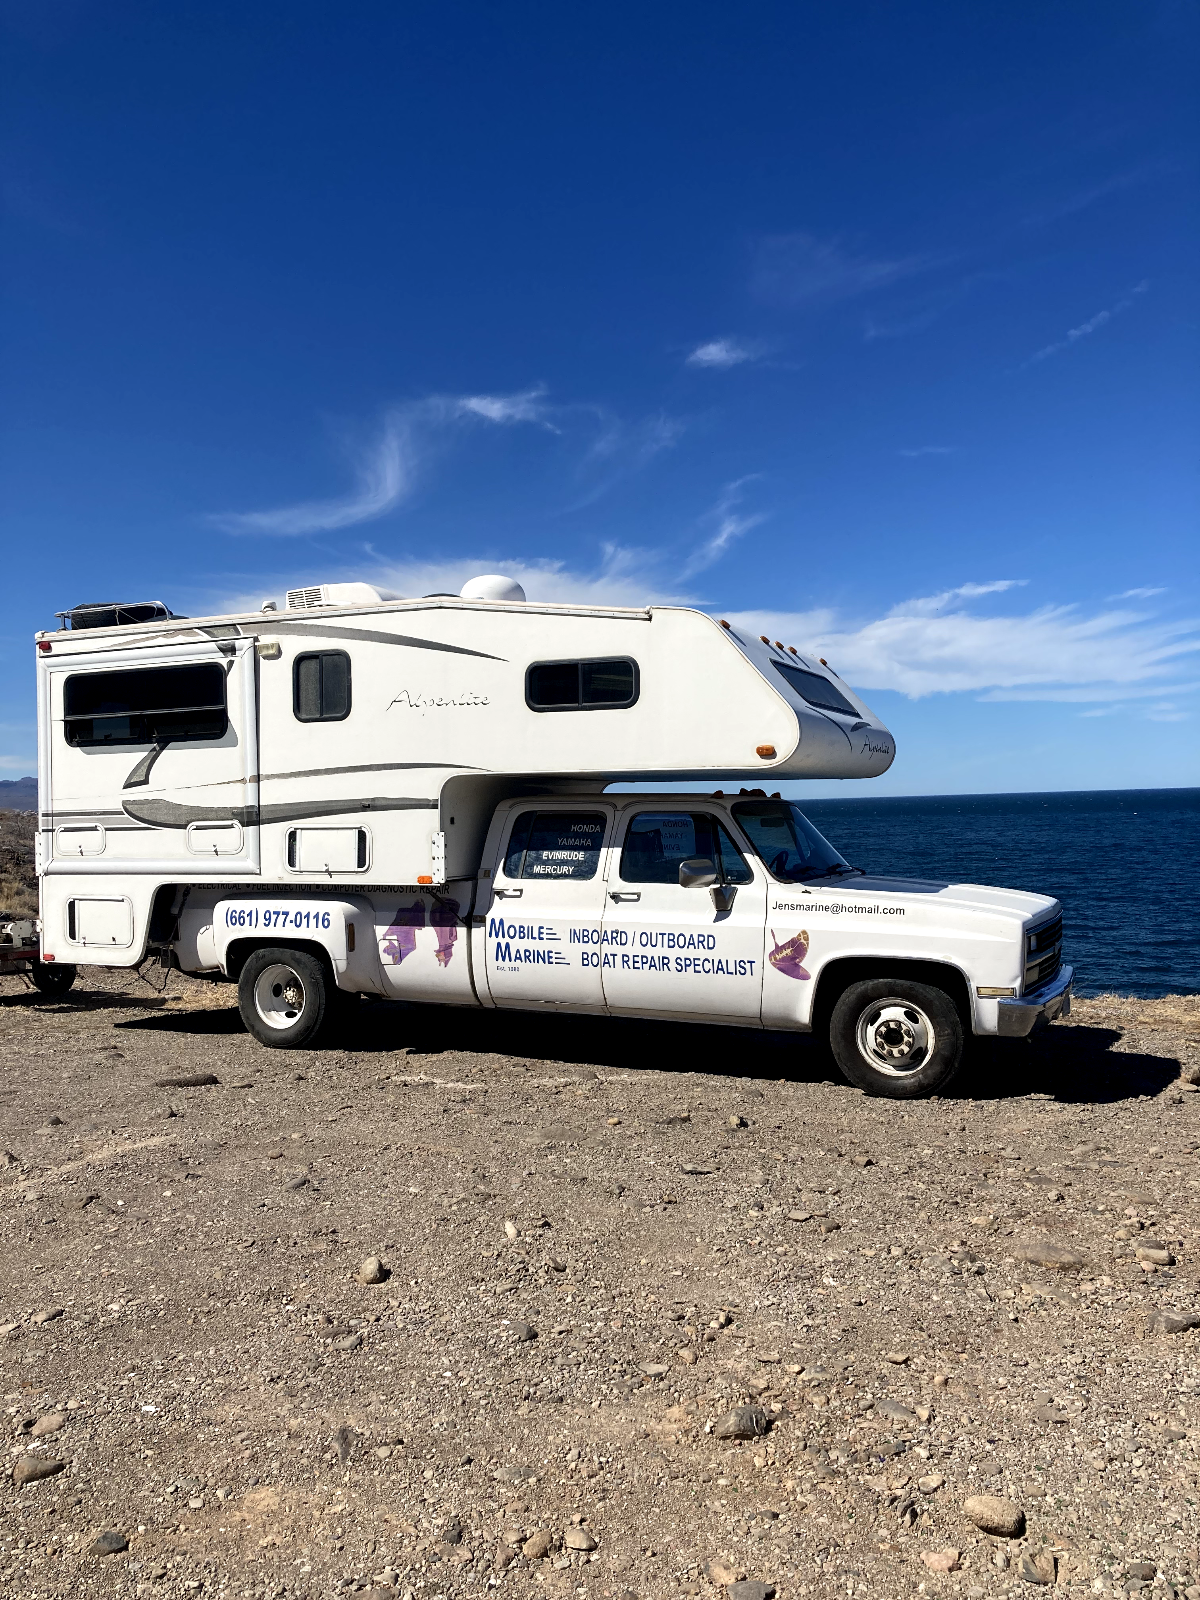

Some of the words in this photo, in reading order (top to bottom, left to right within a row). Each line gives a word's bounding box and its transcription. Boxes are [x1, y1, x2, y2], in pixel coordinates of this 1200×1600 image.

[571, 824, 601, 833] HONDA
[557, 838, 592, 847] YAMAHA
[542, 851, 585, 860] EVINRUDE
[533, 865, 575, 875] MERCURY
[322, 884, 367, 893] COMPUTER
[368, 885, 418, 894] DIAGNOSTIC
[419, 885, 450, 895] REPAIR
[772, 901, 906, 916] Jensmarine@hotmail.com
[225, 907, 259, 929] (661)
[263, 910, 331, 929] 977-0116
[488, 918, 545, 940] MOBILE
[569, 928, 628, 946] INBOARD
[639, 931, 717, 951] OUTBOARD
[495, 941, 554, 964] MARINE
[581, 952, 618, 969] BOAT
[622, 953, 672, 972] REPAIR
[674, 957, 756, 977] SPECIALIST
